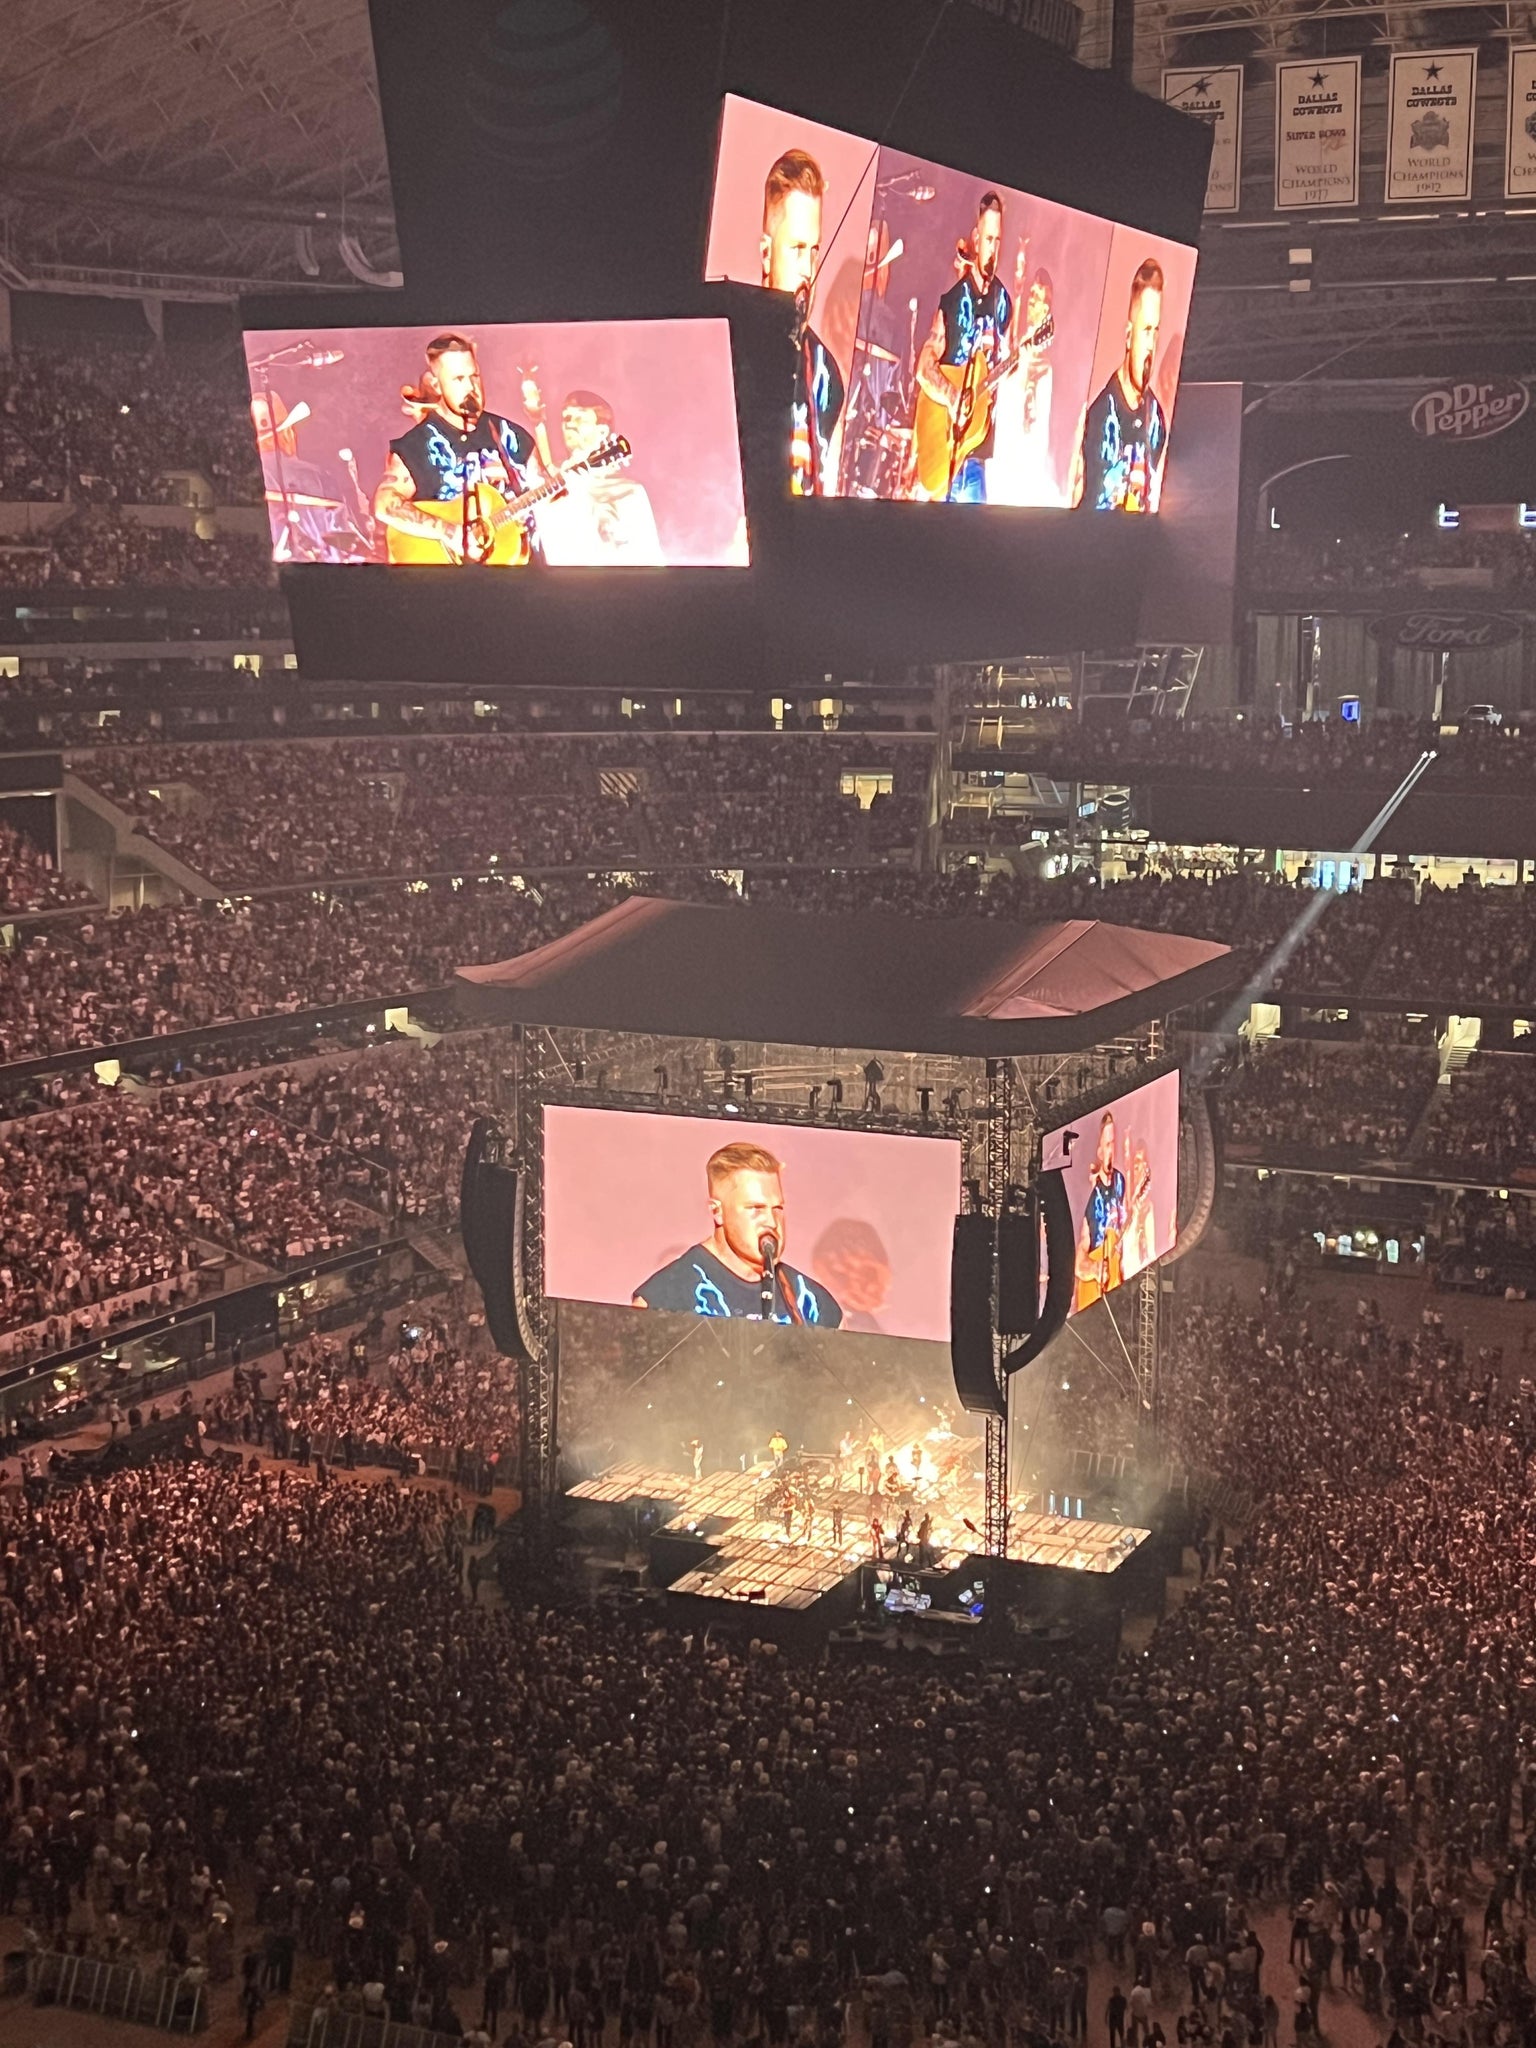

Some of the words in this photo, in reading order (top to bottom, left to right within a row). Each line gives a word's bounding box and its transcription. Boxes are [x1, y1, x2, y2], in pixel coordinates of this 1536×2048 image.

[1412, 85, 1453, 96] DALLAS
[1297, 93, 1338, 104] DALLAS
[1408, 157, 1451, 168] WORLD
[1295, 164, 1338, 175] WORLD
[1393, 170, 1464, 182] CHAMPIONS
[1281, 176, 1351, 189] CHAMPIONS
[1453, 383, 1493, 411] Dr
[1419, 391, 1521, 436] Pepper
[1400, 614, 1492, 644] Ford
